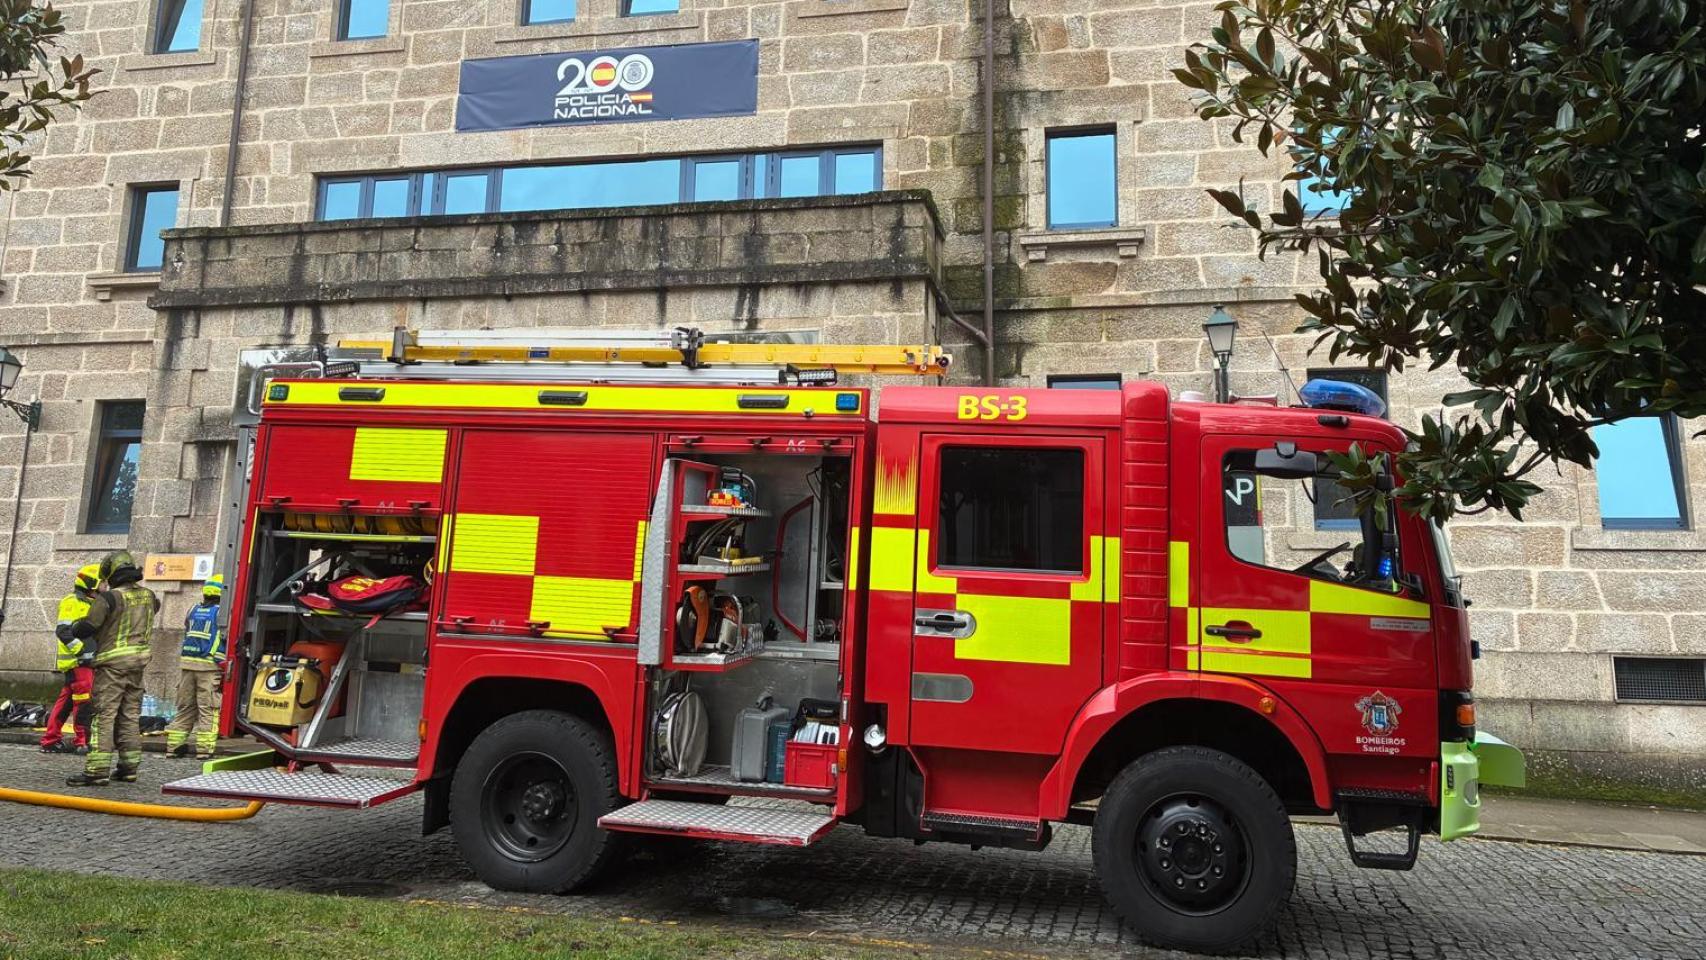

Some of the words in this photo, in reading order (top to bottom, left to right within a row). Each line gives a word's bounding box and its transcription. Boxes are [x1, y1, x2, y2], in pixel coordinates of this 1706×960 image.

[556, 54, 654, 95] 200
[555, 93, 632, 107] POLICIA
[554, 104, 652, 118] NACIONAL
[958, 395, 1027, 420] BS-3
[786, 439, 805, 452] A6
[1355, 736, 1406, 746] BOMBEIROS
[1362, 744, 1400, 755] Santiago
